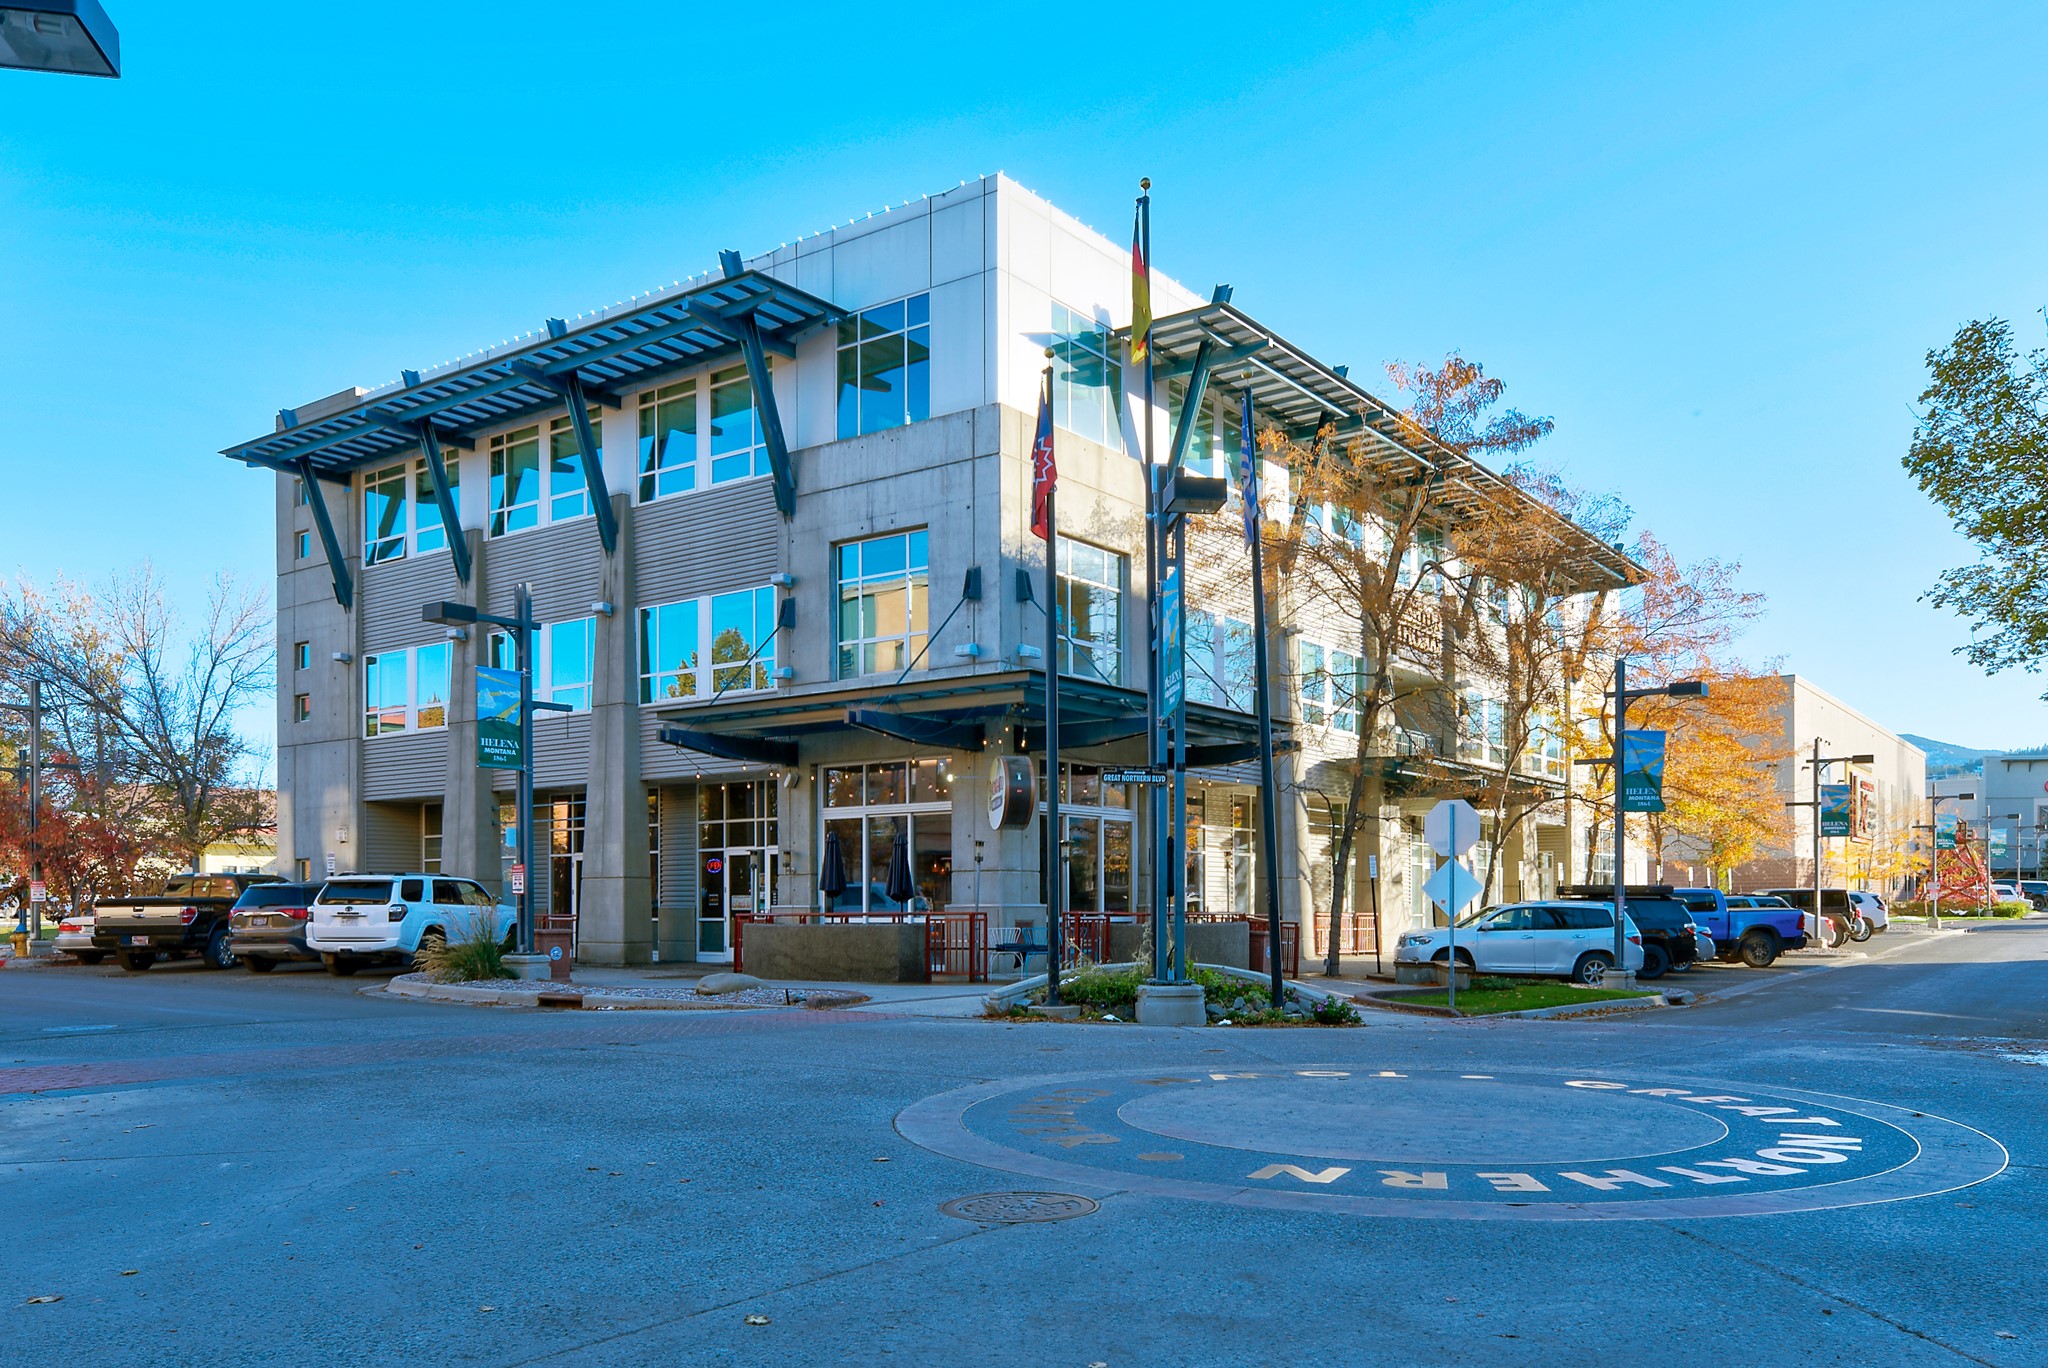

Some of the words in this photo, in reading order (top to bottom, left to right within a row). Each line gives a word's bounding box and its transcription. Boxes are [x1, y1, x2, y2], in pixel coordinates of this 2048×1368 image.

[480, 738, 519, 749] HELENA
[484, 747, 516, 756] MONTANA
[1103, 774, 1121, 782] GREAT
[1122, 774, 1151, 782] NORTHERN
[1151, 775, 1166, 783] BLVD
[1626, 787, 1659, 795] HELEN
[1564, 1079, 1843, 1127] GREAT
[1245, 1132, 1863, 1193] NORTHERN
